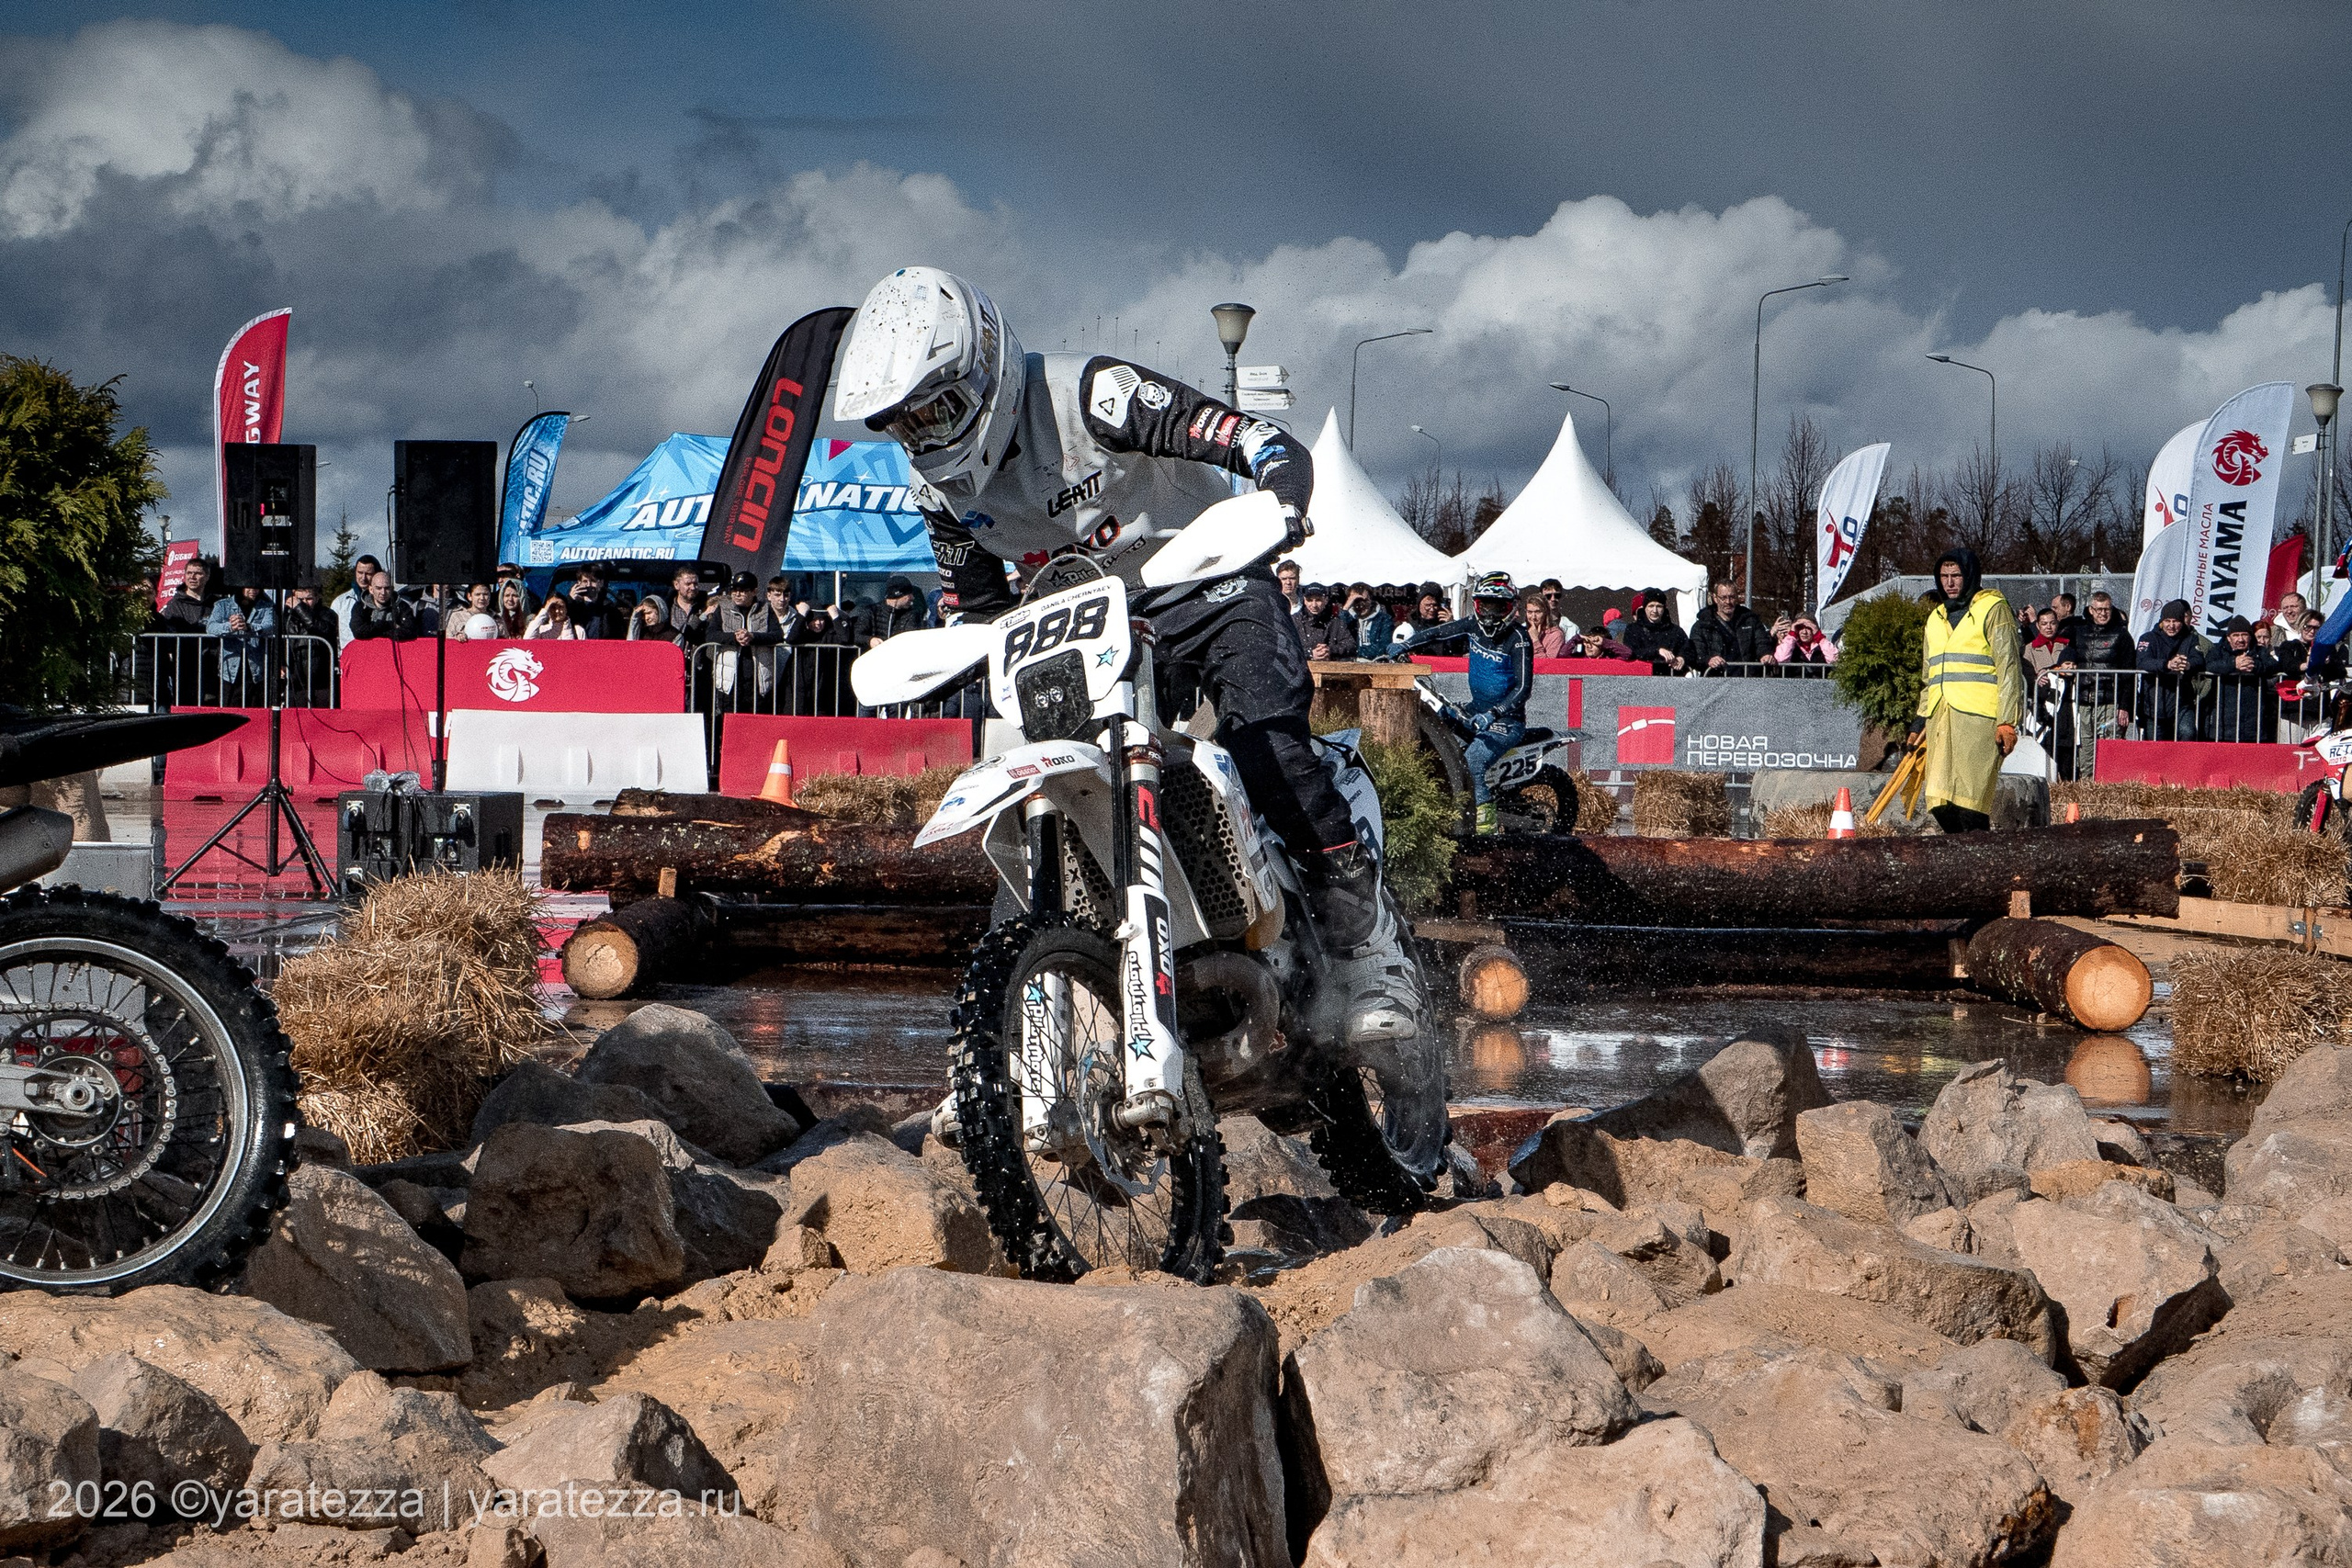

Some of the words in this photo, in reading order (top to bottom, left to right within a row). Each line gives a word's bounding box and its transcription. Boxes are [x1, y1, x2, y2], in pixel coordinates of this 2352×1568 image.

[1047, 469, 1102, 519] LEATT
[2198, 502, 2214, 549] МАСЛА
[560, 547, 676, 560] AUTOFANATIC.RU
[2205, 500, 2248, 637] KAYAMA
[2190, 552, 2209, 626] МОТОРНЫЕ
[1003, 596, 1110, 678] 888
[1687, 734, 1768, 750] НОВАЯ
[1498, 754, 1537, 784] 225
